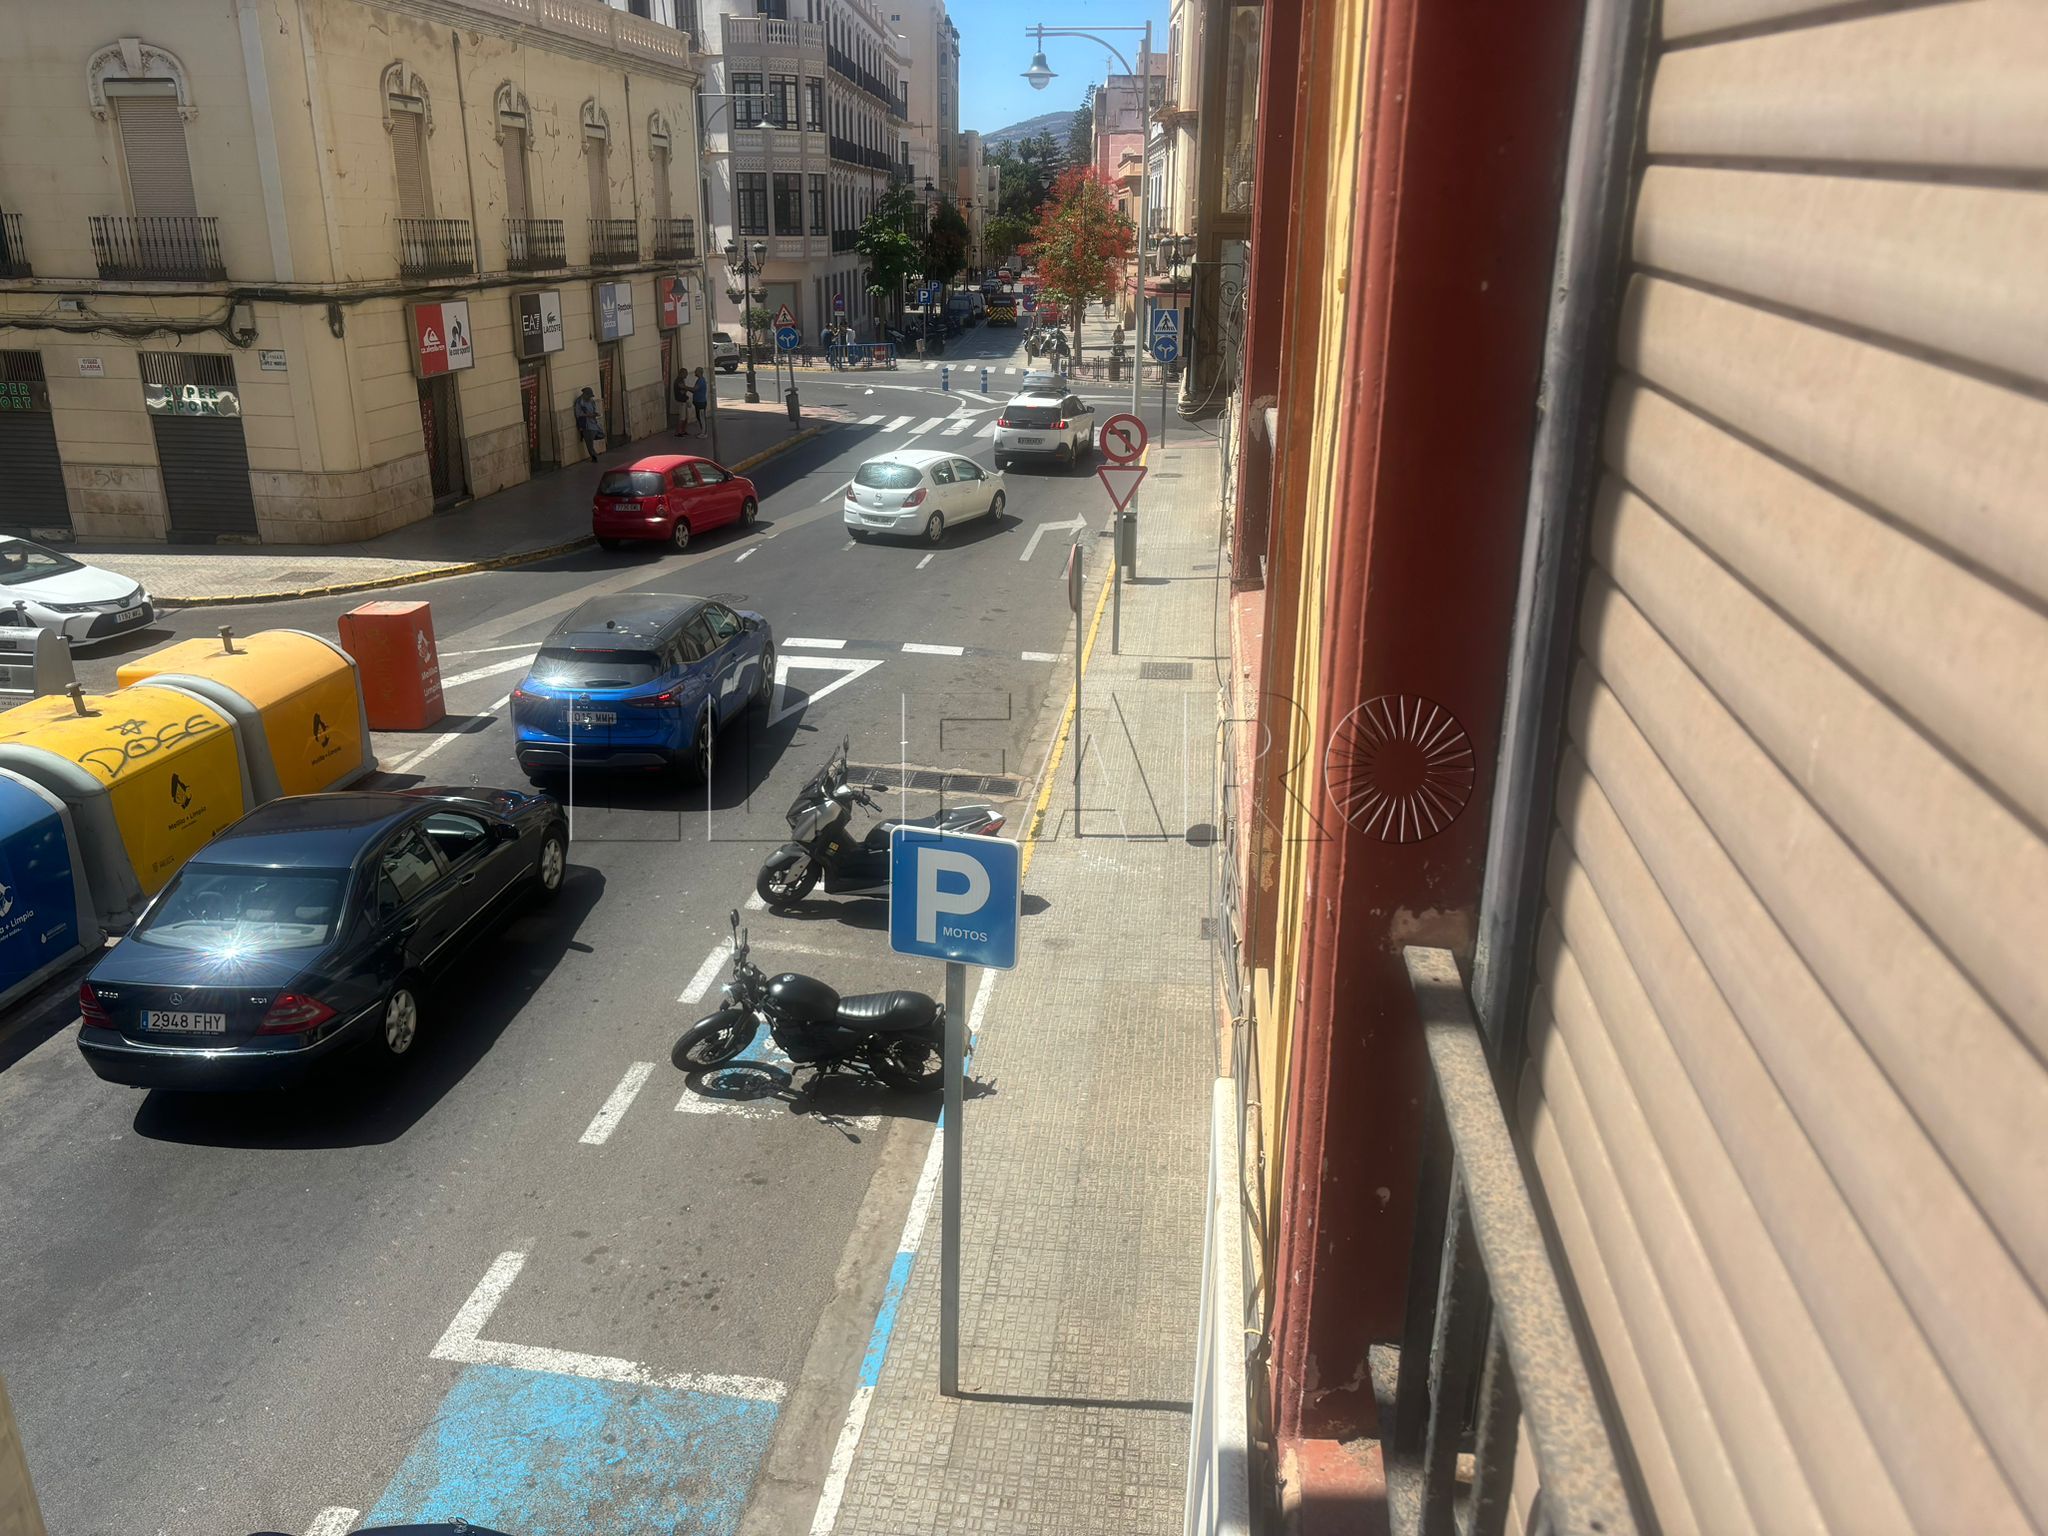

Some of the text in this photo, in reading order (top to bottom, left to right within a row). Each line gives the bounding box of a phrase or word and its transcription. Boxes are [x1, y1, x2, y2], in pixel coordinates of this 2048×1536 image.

[931, 282, 938, 291] P
[920, 290, 929, 302] P
[543, 323, 561, 334] LACOSTE
[164, 385, 219, 399] SUPER
[166, 400, 219, 413] SPORT
[916, 847, 991, 944] P
[10, 910, 34, 928] Limpia
[942, 926, 989, 943] MOTOS
[152, 1013, 222, 1030] 2948 FHY
